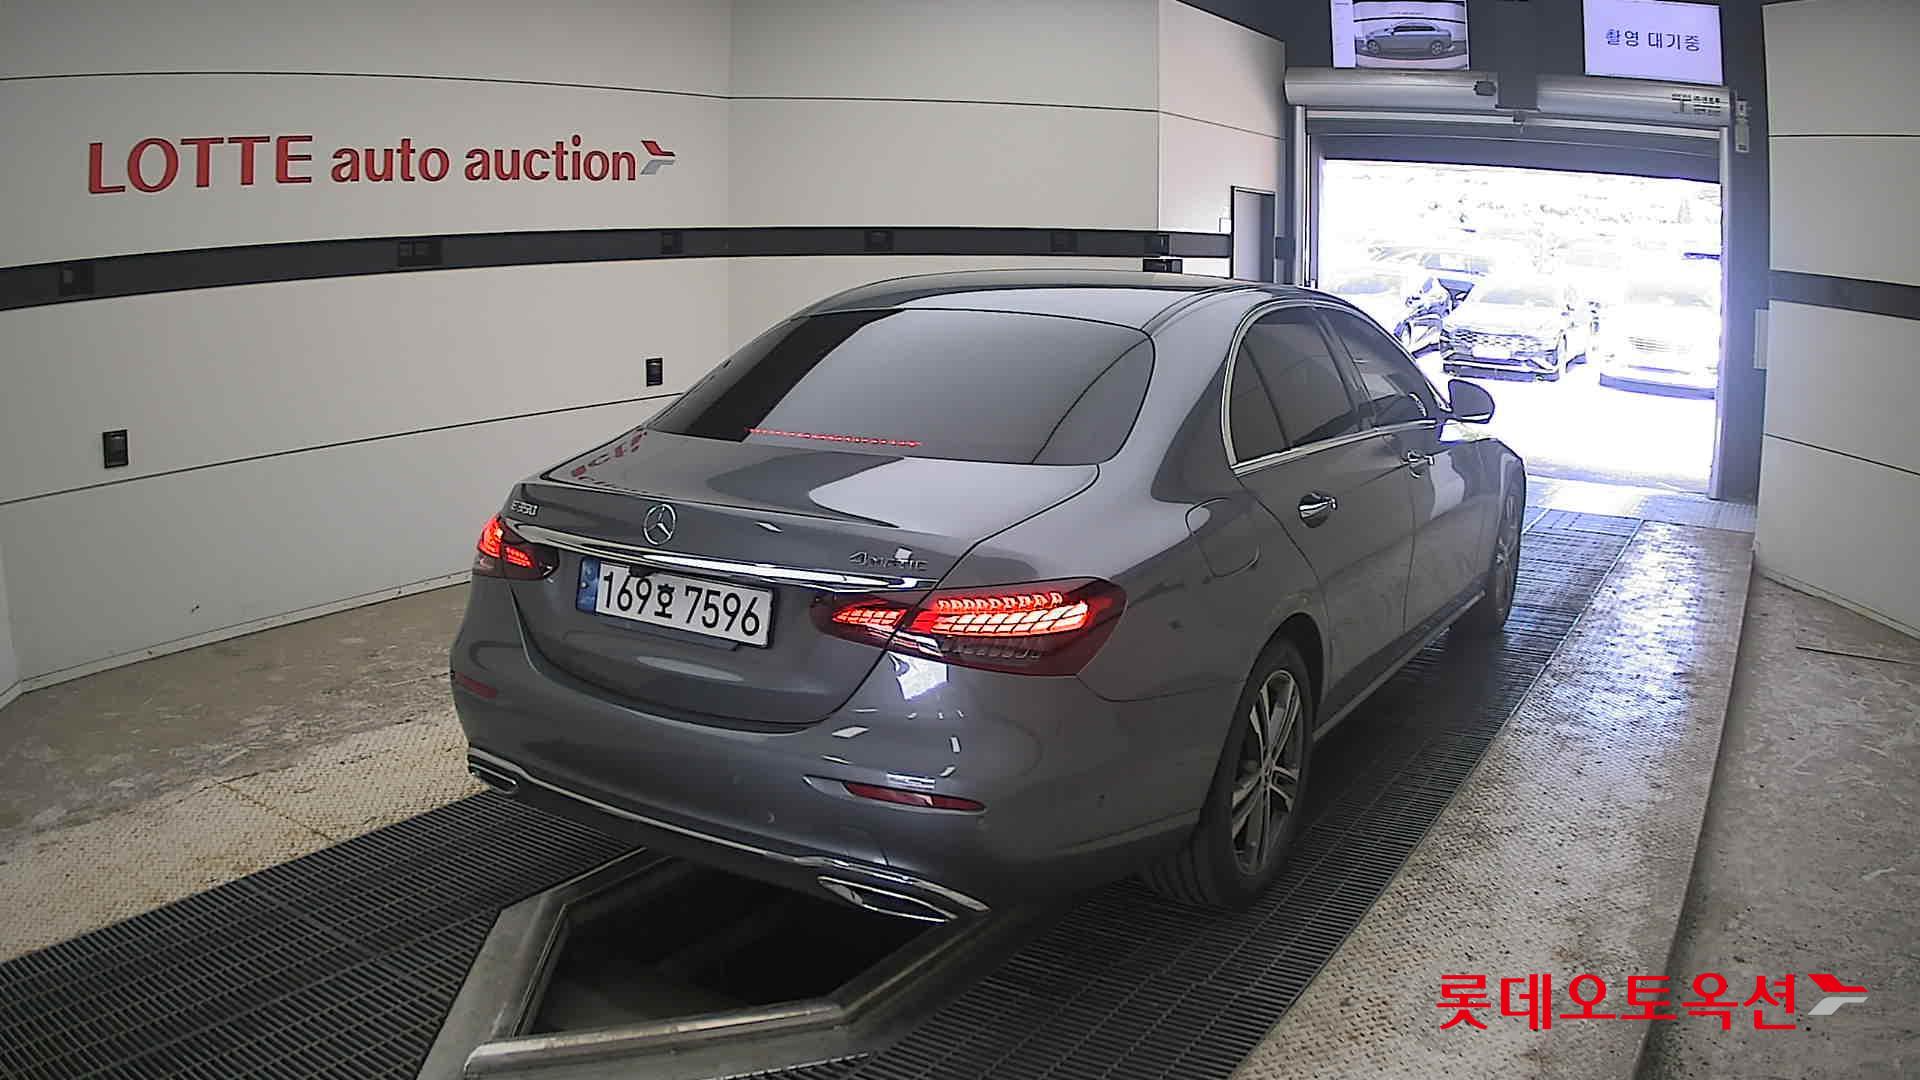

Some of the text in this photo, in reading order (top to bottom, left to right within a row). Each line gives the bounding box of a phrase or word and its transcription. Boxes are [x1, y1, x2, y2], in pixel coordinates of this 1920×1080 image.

[1647, 31, 1701, 52] 대기중
[88, 135, 637, 194] LOTTE auto auction
